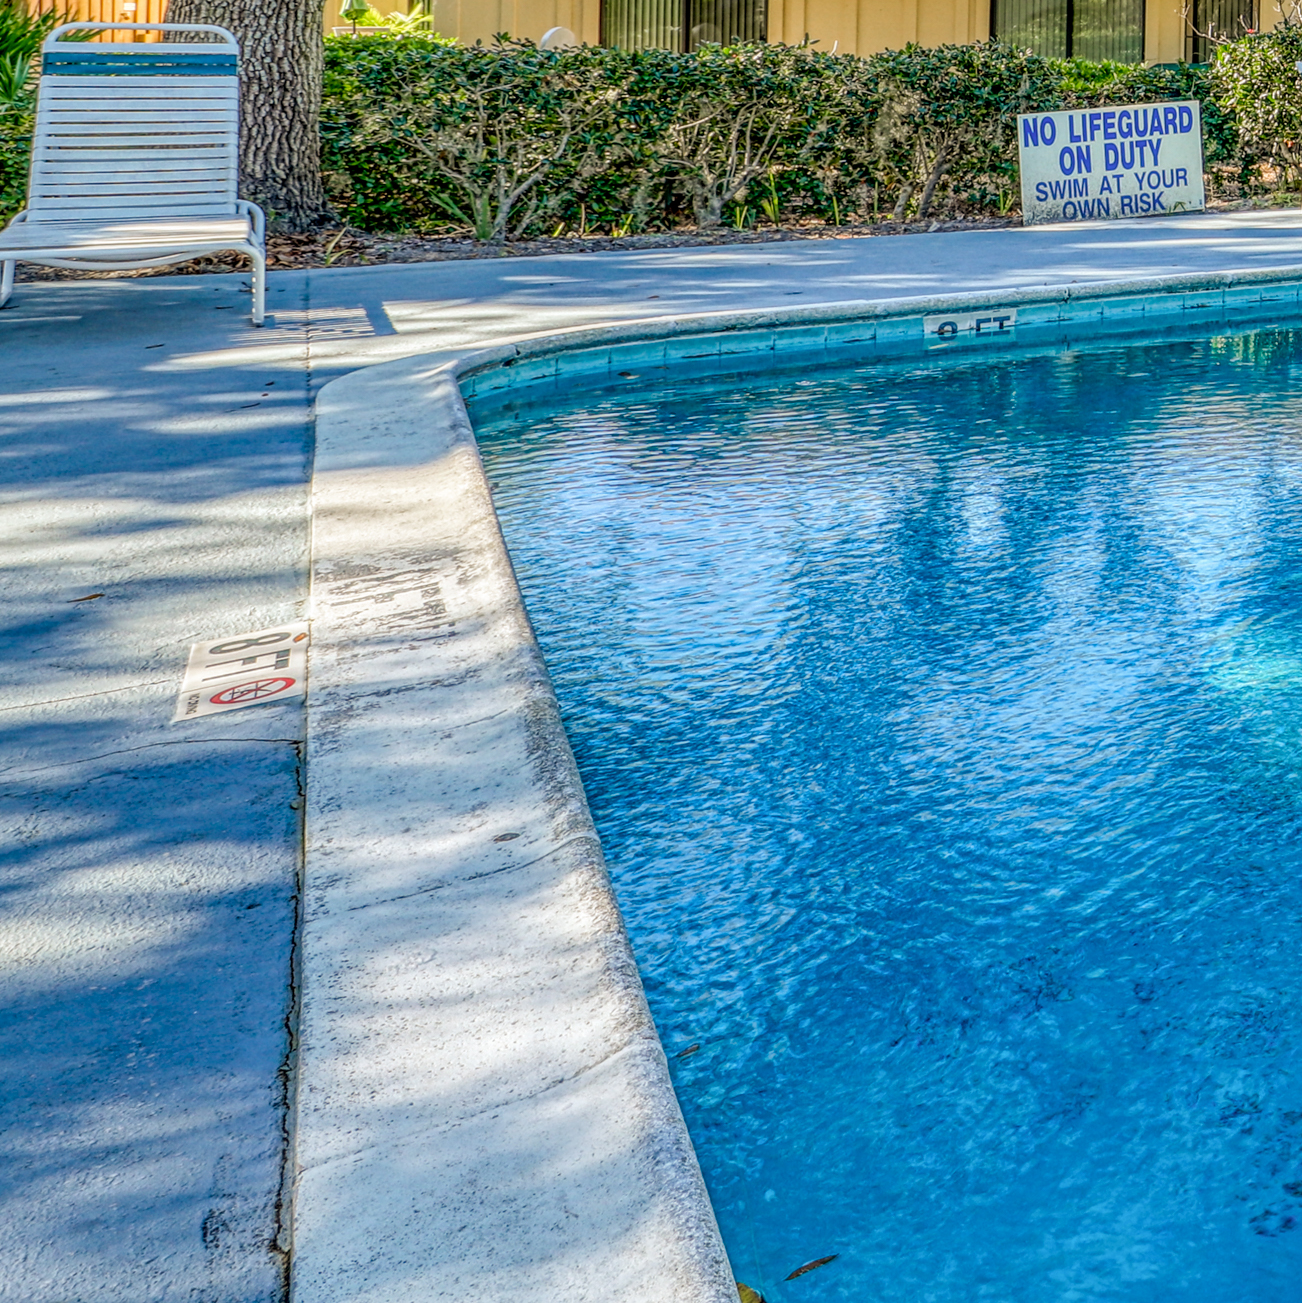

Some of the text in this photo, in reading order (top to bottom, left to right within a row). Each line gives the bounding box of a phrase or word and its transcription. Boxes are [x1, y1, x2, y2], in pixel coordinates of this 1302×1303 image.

[1023, 106, 1193, 147] NO LIFEGUARD
[1059, 138, 1162, 176] ON DUTY
[1035, 168, 1188, 202] SWIM AT YOUR
[1063, 191, 1166, 220] OWN RISK
[202, 632, 291, 682] 8 FT
